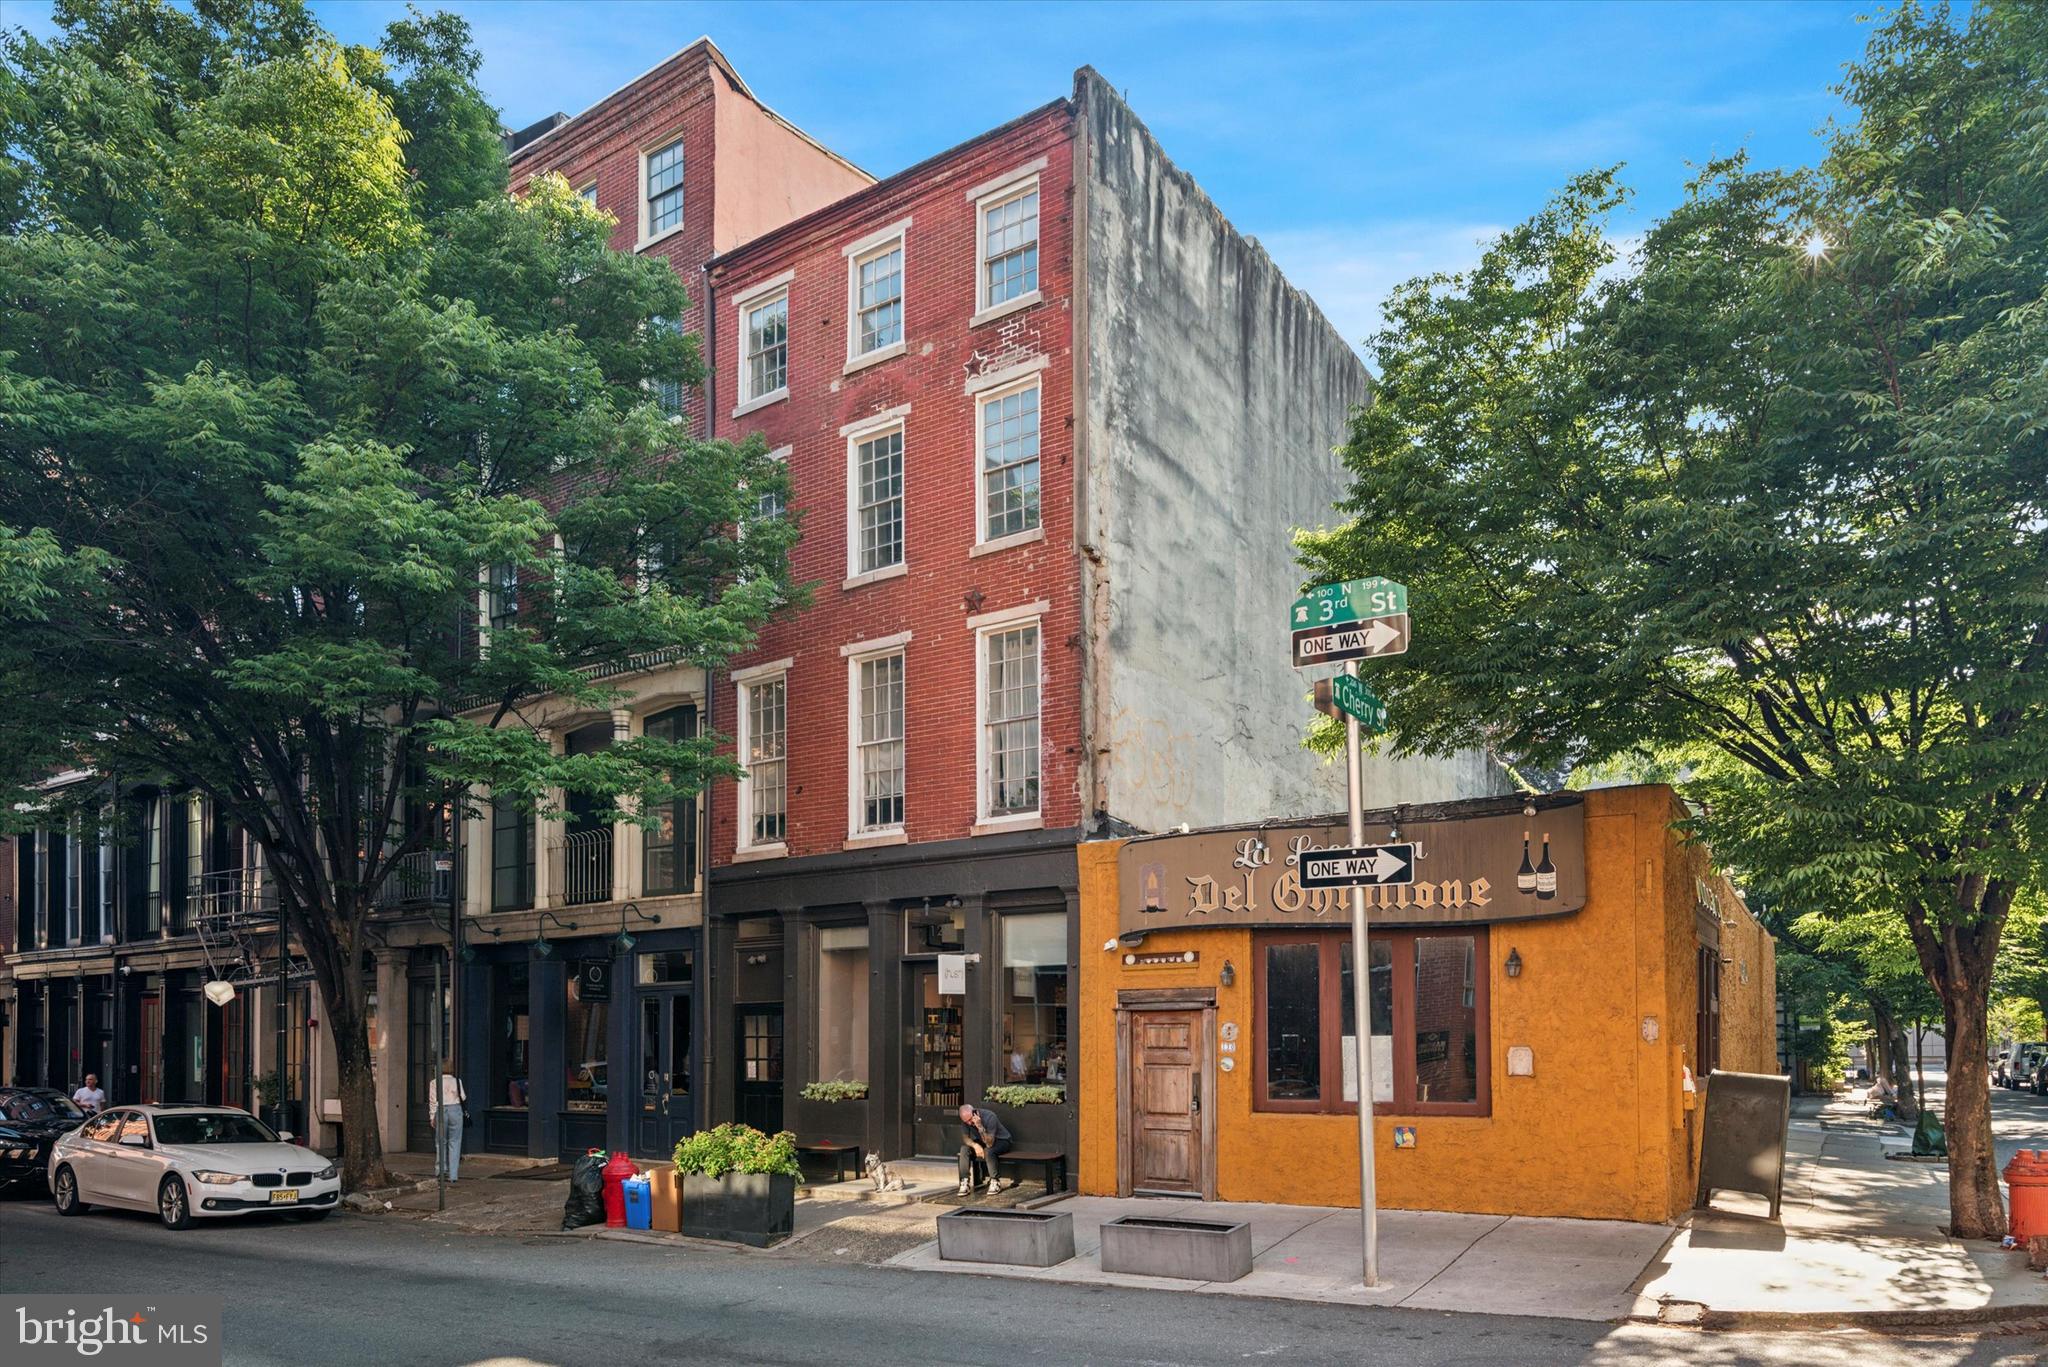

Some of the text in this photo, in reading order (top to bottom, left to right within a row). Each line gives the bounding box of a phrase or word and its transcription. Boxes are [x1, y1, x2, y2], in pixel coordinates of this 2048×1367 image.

[1317, 580, 1378, 598] 100 N 199
[1319, 591, 1397, 621] 3rd St
[1303, 630, 1371, 655] ONE WAY
[1342, 685, 1374, 725] Cherry
[1233, 837, 1274, 868] La
[1310, 858, 1378, 877] ONE WAY
[1185, 869, 1258, 917] Del
